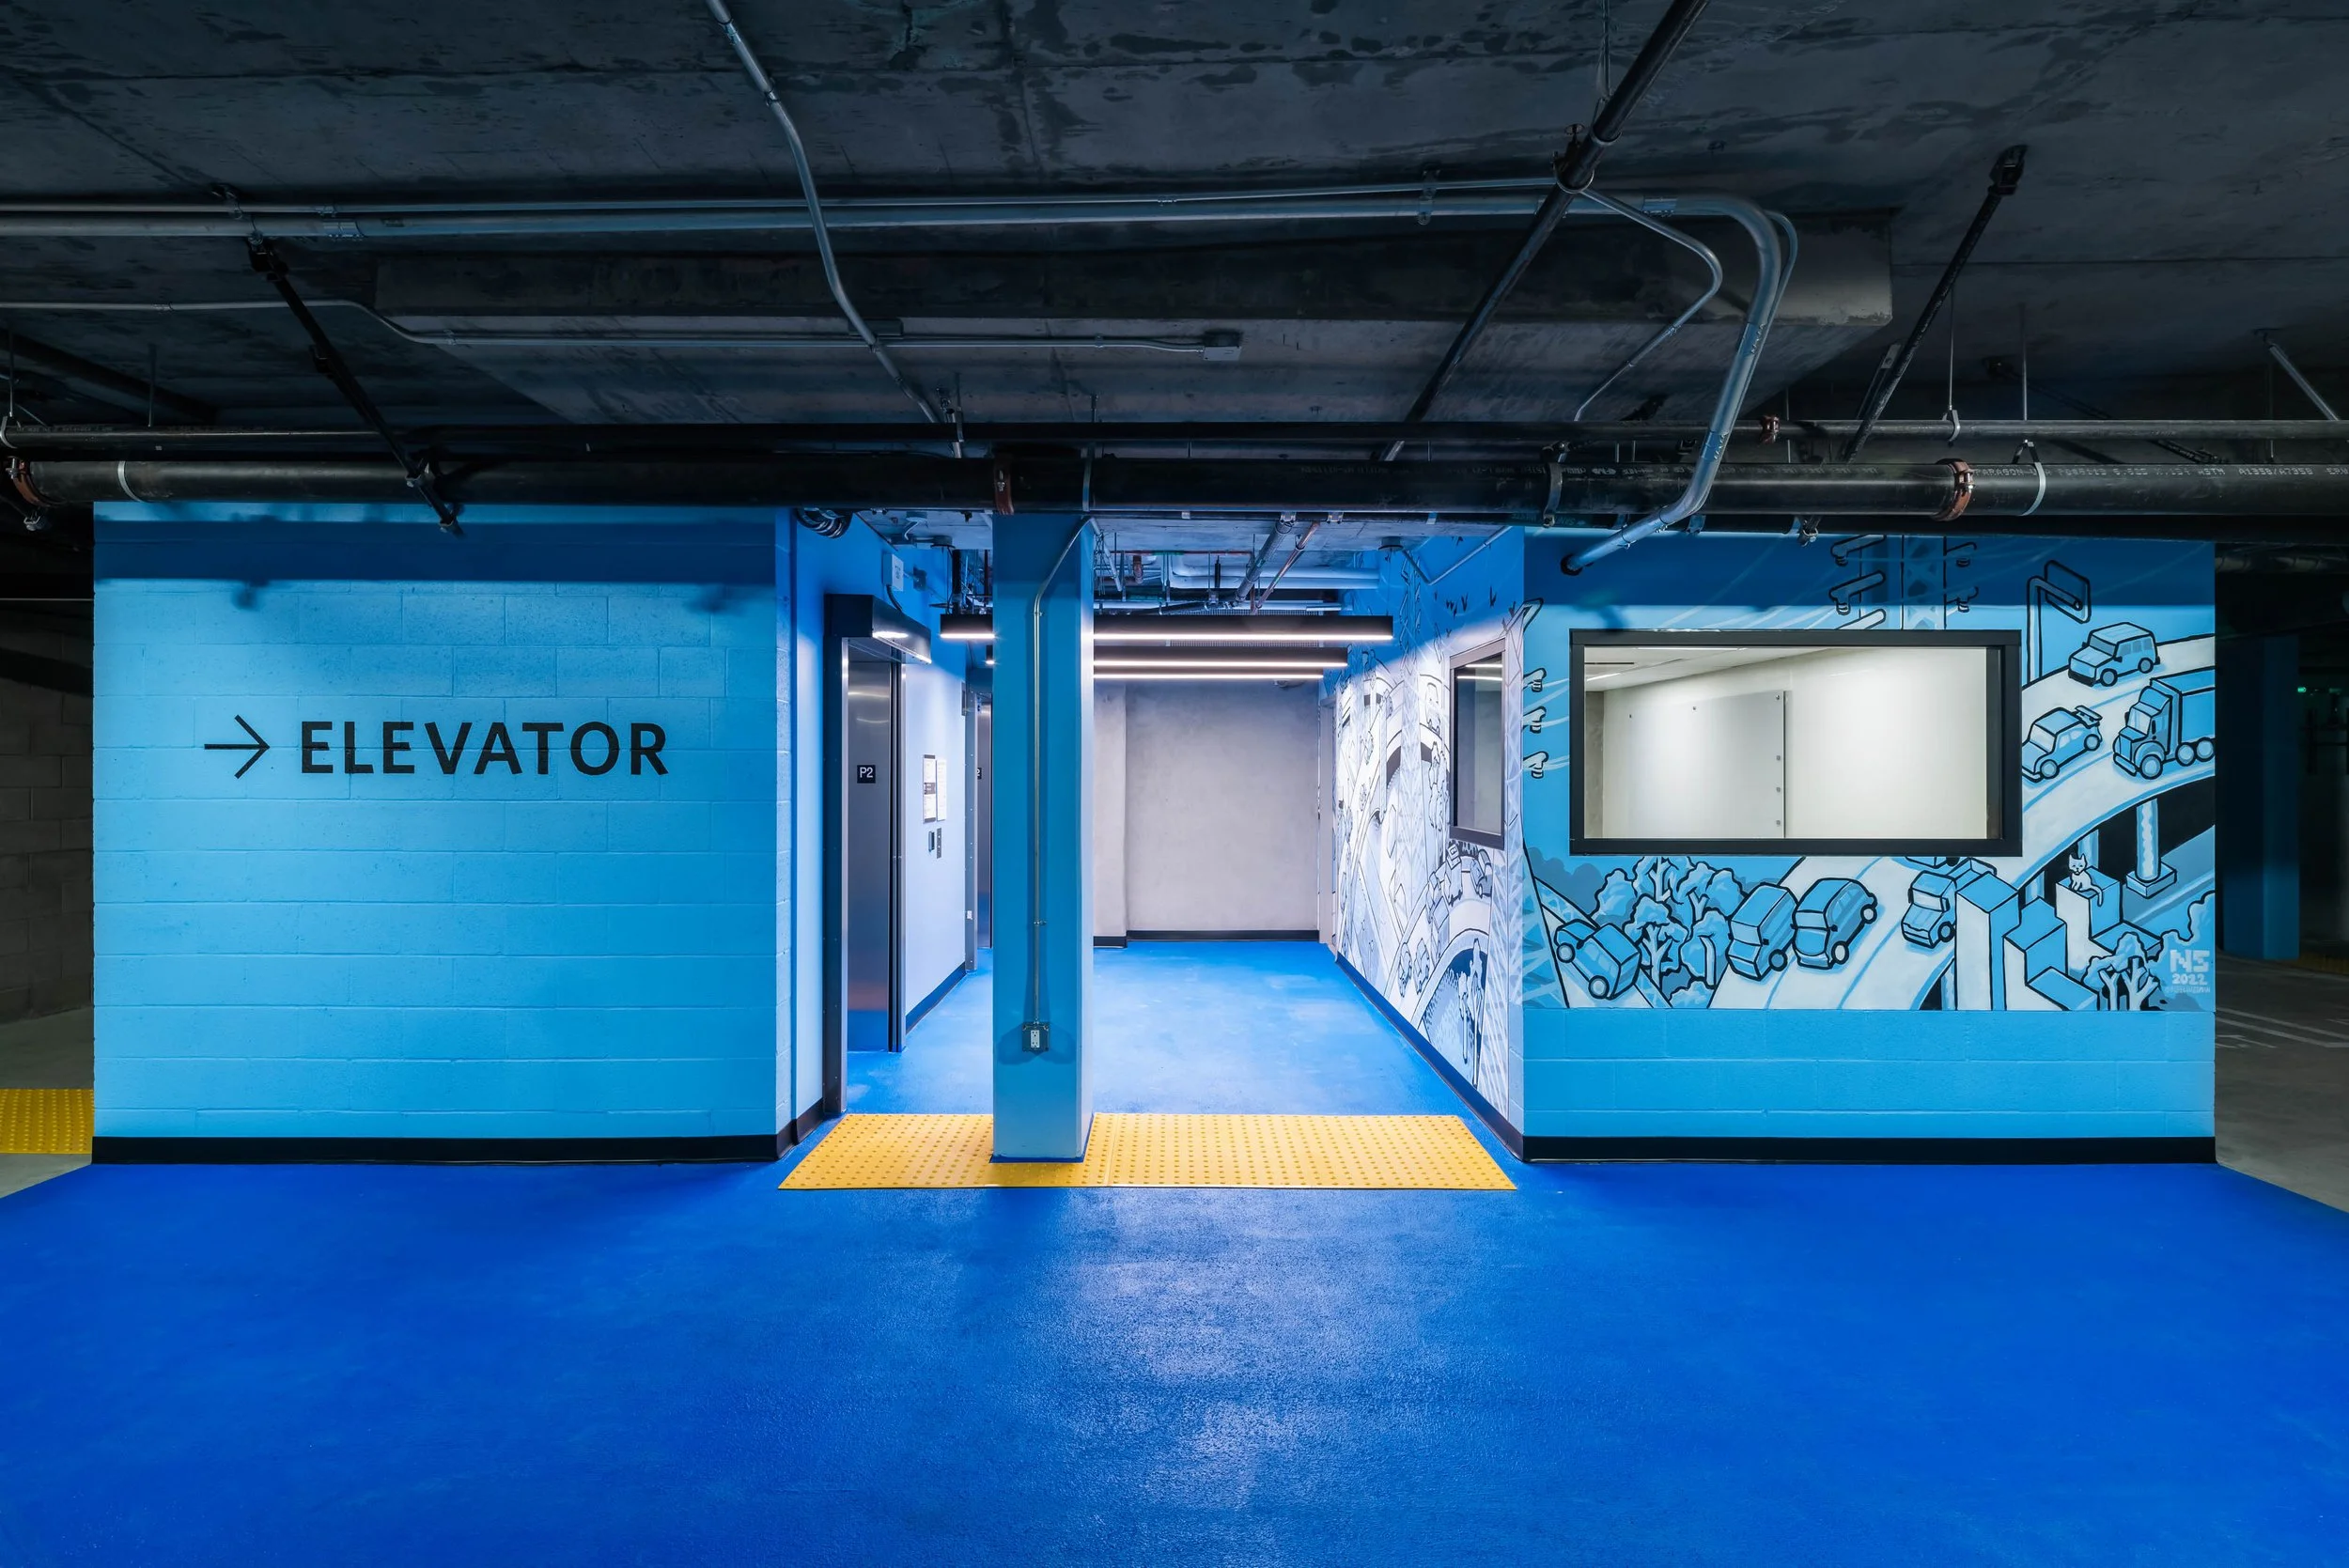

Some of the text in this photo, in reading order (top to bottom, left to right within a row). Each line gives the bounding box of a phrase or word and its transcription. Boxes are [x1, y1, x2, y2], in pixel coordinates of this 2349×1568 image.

[301, 721, 669, 776] ELEVATOR
[859, 767, 874, 779] P2
[2170, 949, 2210, 972] NS
[2171, 973, 2208, 986] 2022
